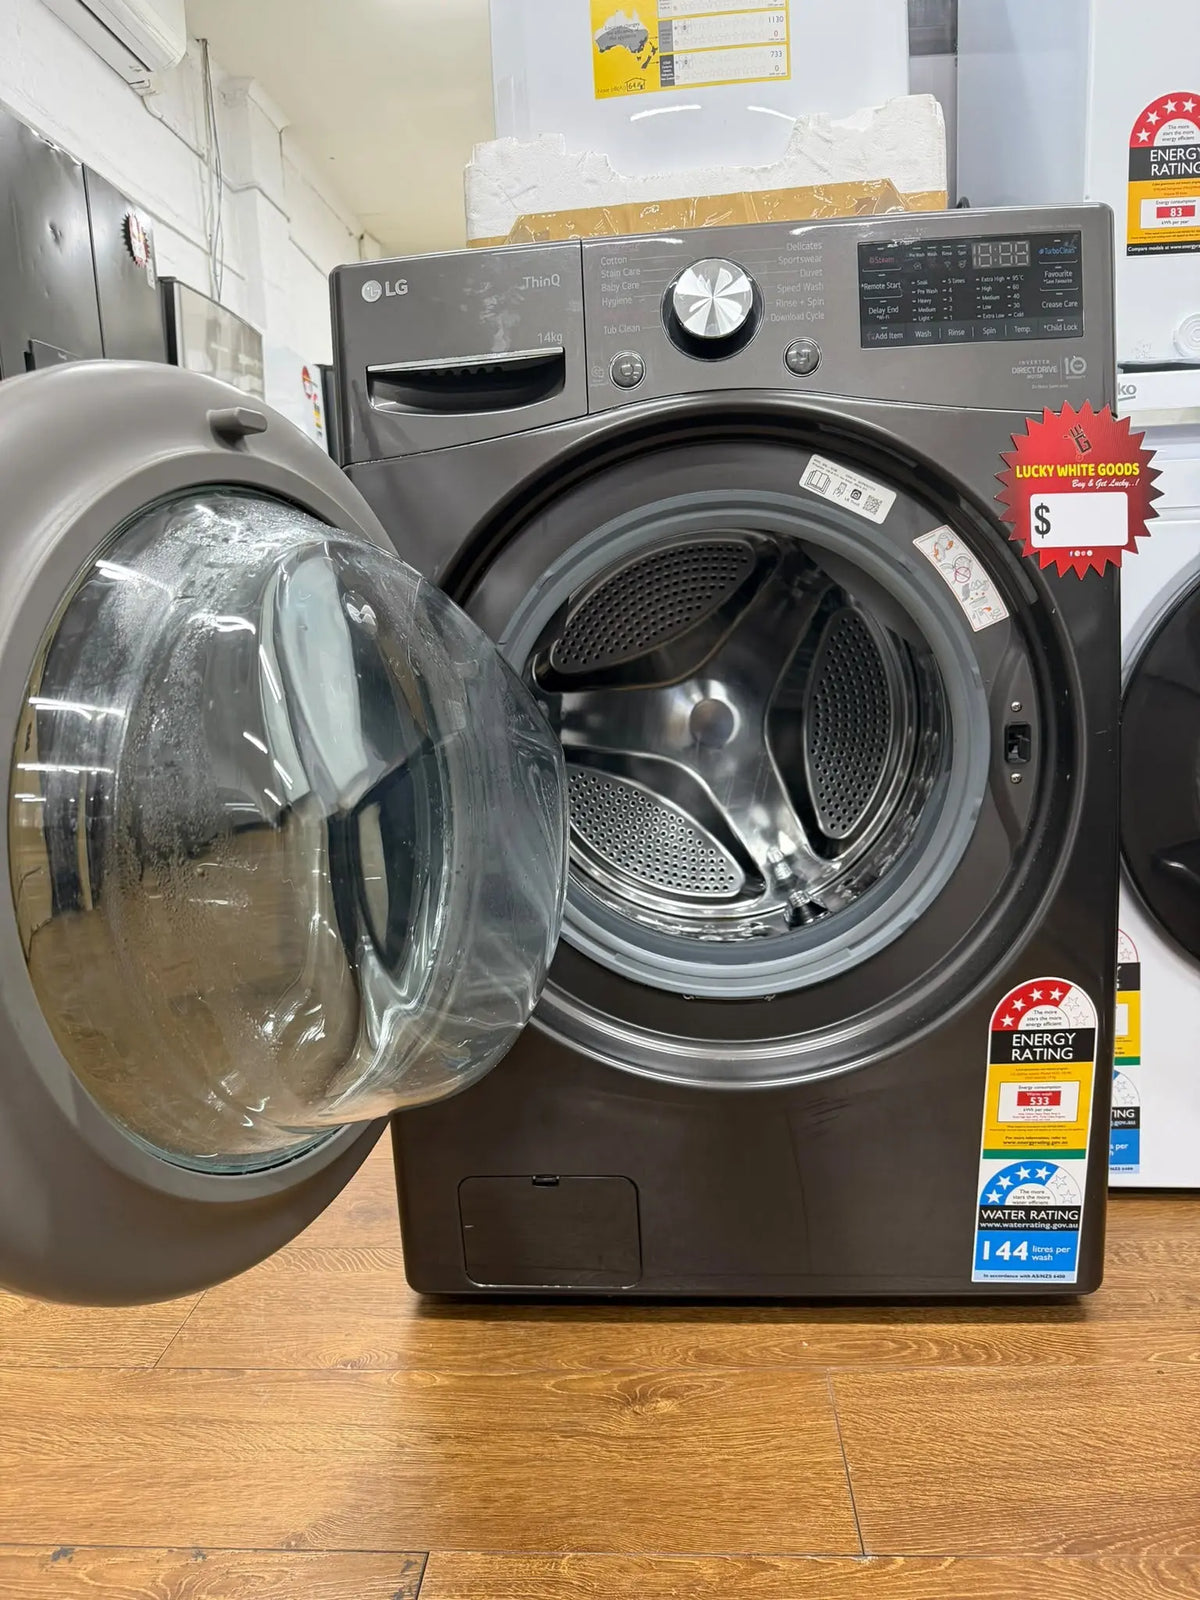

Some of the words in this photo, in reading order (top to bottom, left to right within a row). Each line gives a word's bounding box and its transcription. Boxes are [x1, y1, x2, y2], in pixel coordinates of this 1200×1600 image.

[768, 15, 784, 23] 1130
[1150, 147, 1200, 161] ENERG
[1170, 207, 1182, 217] 83
[786, 241, 822, 251] Delicates
[600, 256, 627, 266] Cotton
[778, 254, 822, 265] Sportswear
[601, 269, 620, 279] Stain
[622, 267, 640, 276] Care
[800, 268, 823, 277] Duvet
[1044, 270, 1072, 278] Favourite
[522, 273, 560, 289] ThinQ
[385, 278, 408, 297] LG
[601, 283, 620, 293] Baby
[621, 281, 640, 290] Care
[777, 283, 800, 294] Speed
[803, 282, 824, 290] Wash
[601, 296, 632, 308] Hygiene
[776, 298, 798, 307] Rinse
[807, 297, 824, 307] Spin
[1041, 301, 1063, 309] Crease
[868, 307, 885, 315] Delay
[887, 305, 899, 313] End
[770, 312, 804, 322] Download
[805, 310, 824, 322] Cycle
[603, 326, 617, 335] Tub
[618, 324, 640, 333] Clean
[948, 328, 965, 336] Rinse
[982, 327, 996, 336] Spin
[1063, 323, 1078, 331] Lock
[537, 331, 563, 345] 14kg
[915, 329, 932, 338] Wash
[1011, 366, 1035, 374] DIRECT
[1037, 365, 1057, 373] DRIVE
[1015, 464, 1054, 479] LUCKY
[1057, 463, 1096, 477] WHITE
[1097, 462, 1140, 477] GOODS
[1072, 478, 1086, 489] Buy
[1088, 479, 1094, 487] &
[1095, 478, 1107, 489] Get
[1034, 502, 1051, 538] $
[1012, 1032, 1076, 1047] ENERGY
[1011, 1047, 1073, 1062] RATING
[1029, 1096, 1050, 1106] 533
[981, 1209, 1026, 1220] WATER
[1029, 1210, 1079, 1220] RATING
[979, 1221, 1079, 1230] www.waterrating.gov.au
[982, 1240, 1029, 1261] 144
[1032, 1244, 1053, 1253] litres
[1055, 1246, 1071, 1255] per
[1032, 1253, 1053, 1261] wash
